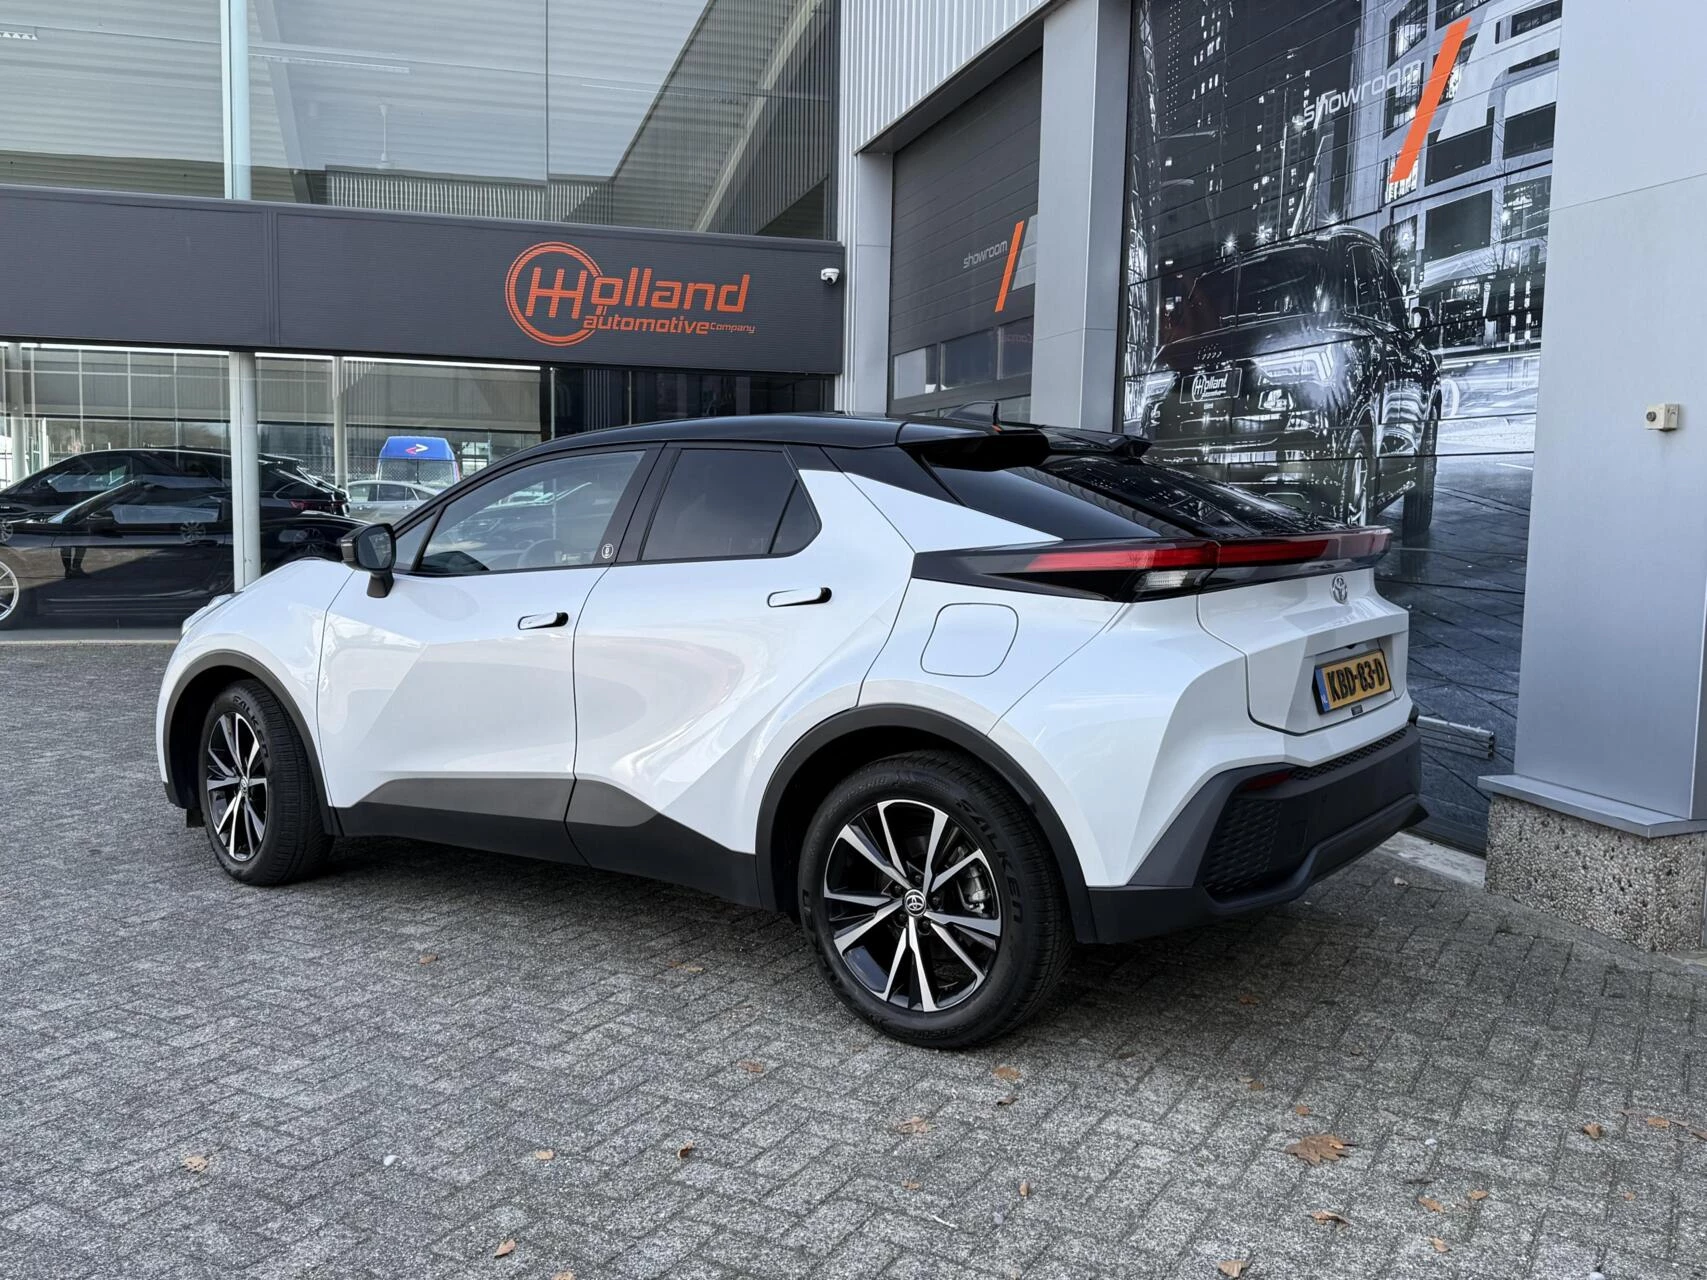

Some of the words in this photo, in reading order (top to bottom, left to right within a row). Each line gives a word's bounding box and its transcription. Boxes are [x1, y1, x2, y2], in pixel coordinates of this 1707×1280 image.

[1304, 59, 1422, 125] showroom
[963, 240, 1008, 269] showroom
[583, 313, 710, 335] automotive
[1327, 657, 1385, 702] KBD-83-D
